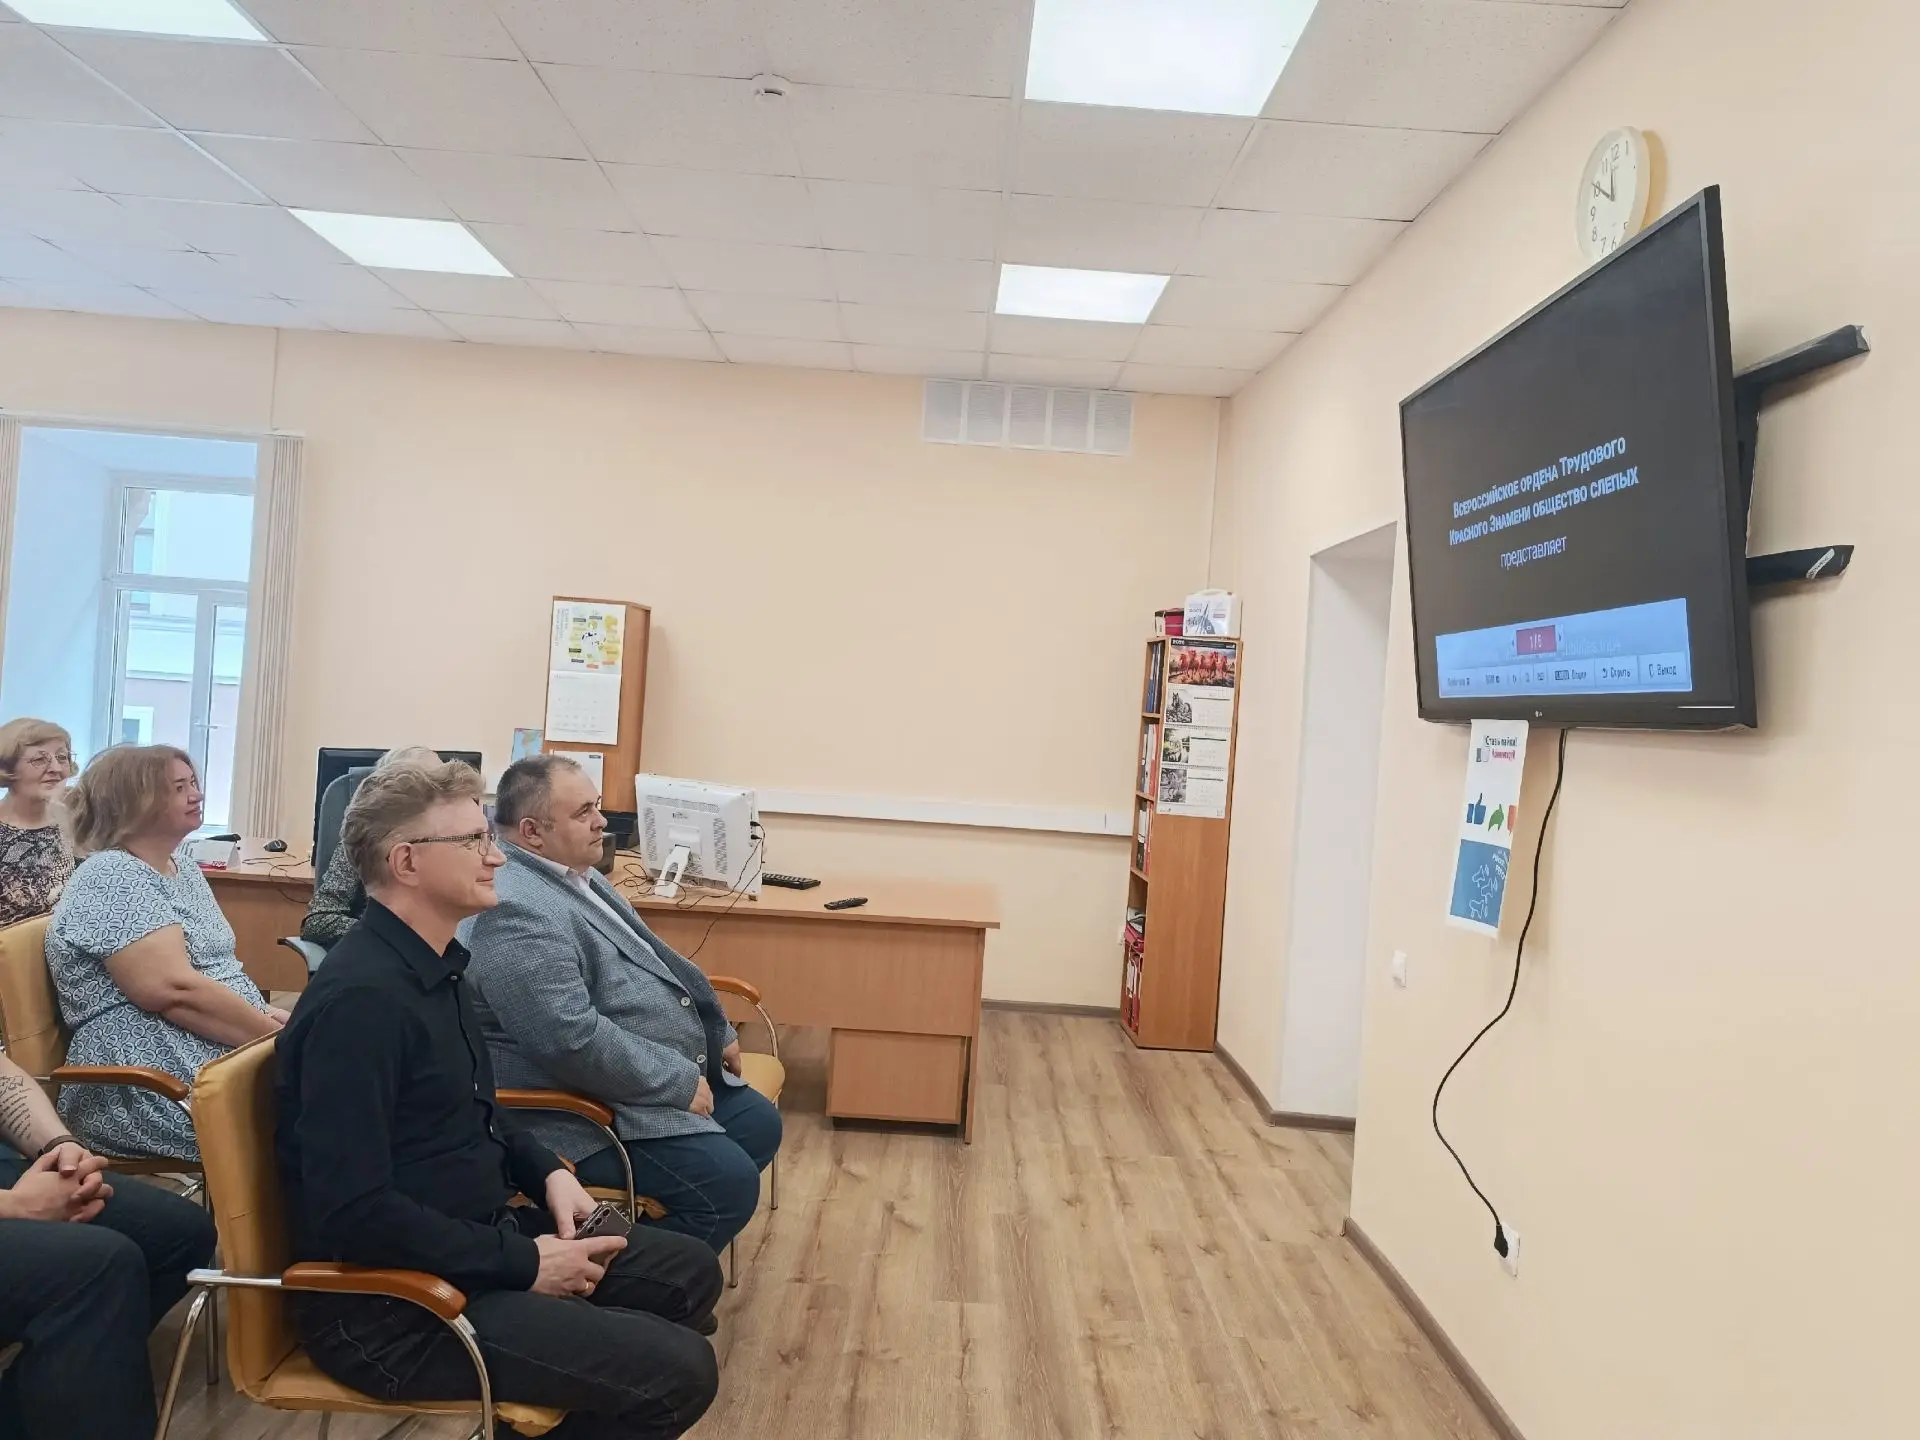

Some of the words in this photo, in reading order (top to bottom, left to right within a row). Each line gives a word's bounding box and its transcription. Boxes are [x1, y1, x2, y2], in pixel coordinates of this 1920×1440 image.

[1611, 143, 1620, 161] 12
[1601, 157, 1608, 175] 11
[1590, 205, 1597, 221] 9
[1591, 226, 1598, 242] 8
[1600, 236, 1607, 253] 7
[1500, 536, 1567, 570] представляет
